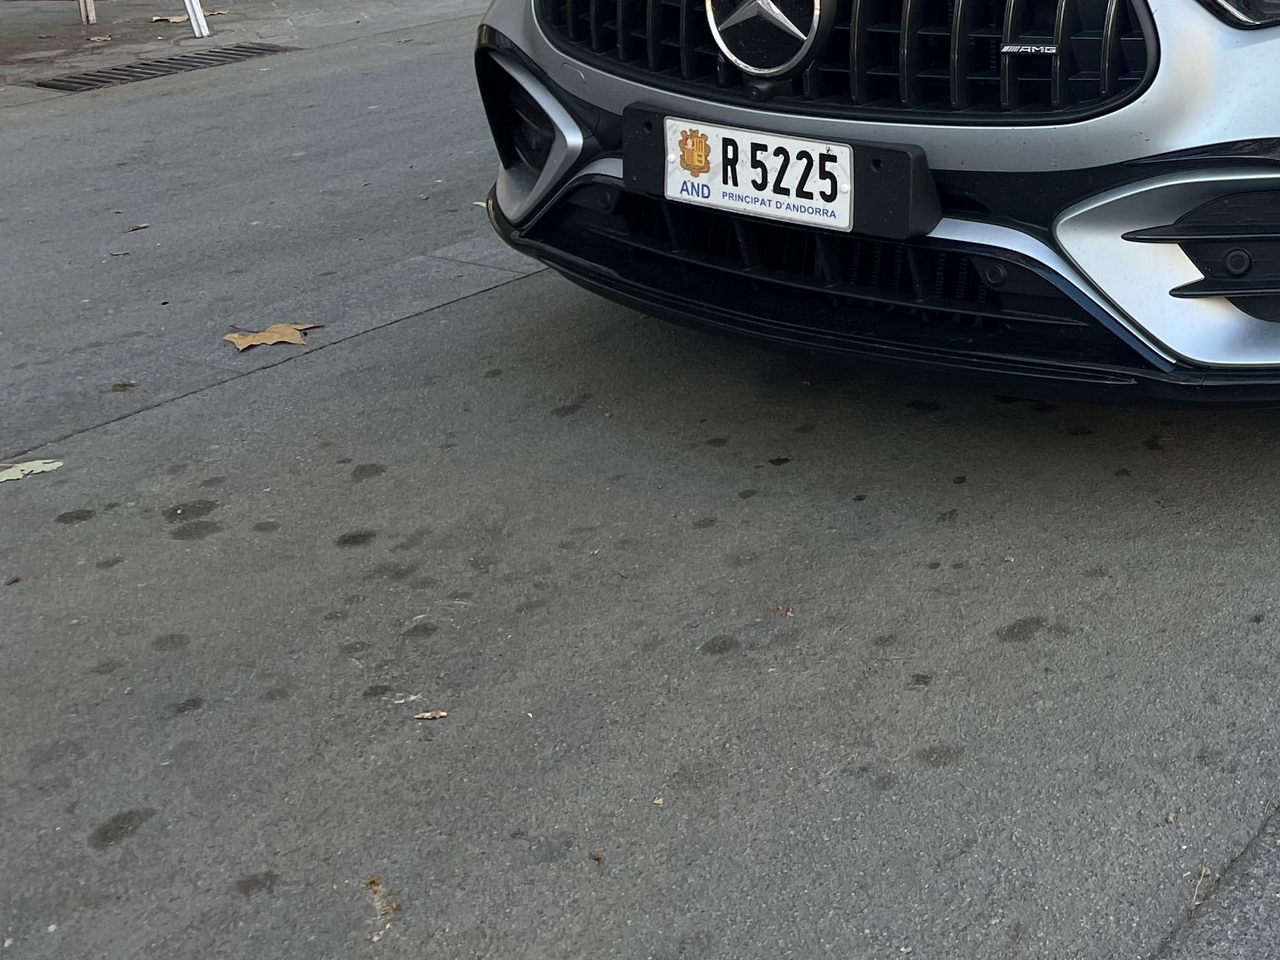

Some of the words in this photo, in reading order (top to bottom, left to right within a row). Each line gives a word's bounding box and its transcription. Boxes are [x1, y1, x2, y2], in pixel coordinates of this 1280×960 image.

[721, 137, 739, 187] R
[750, 142, 838, 203] 5225
[679, 180, 711, 199] AND
[721, 191, 773, 208] PRINCIPAT
[775, 200, 837, 219] D'ANDORRA
